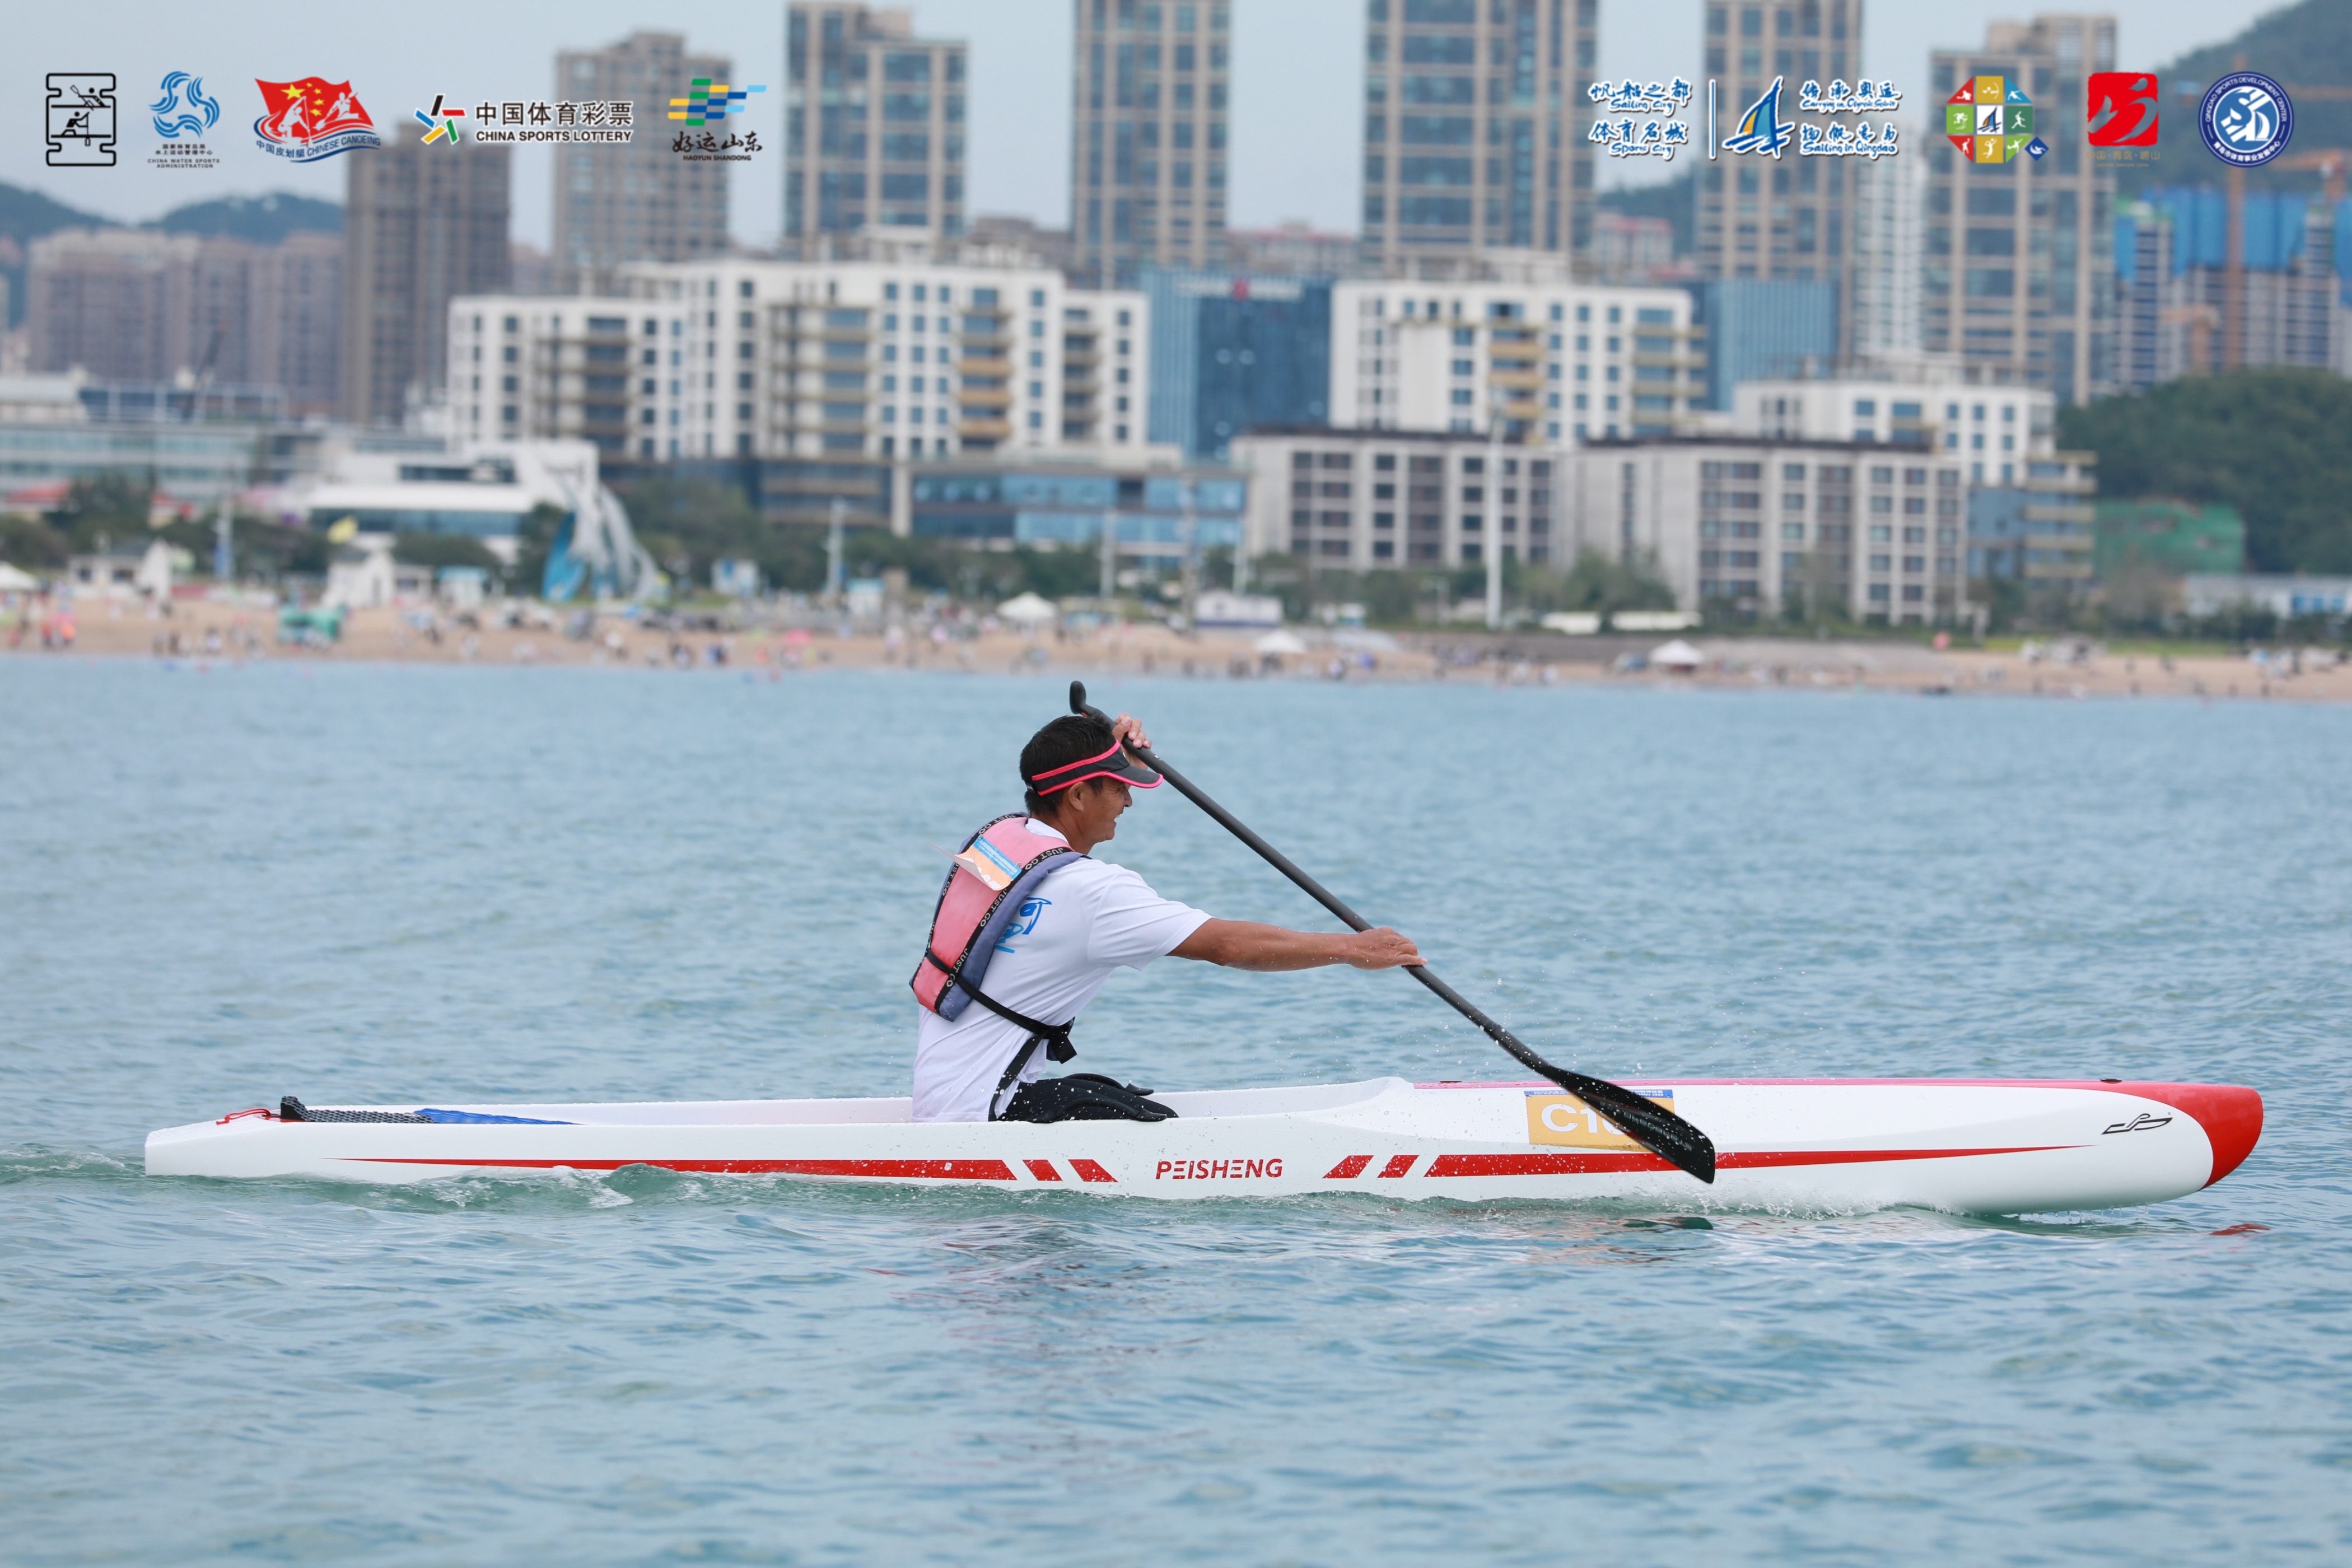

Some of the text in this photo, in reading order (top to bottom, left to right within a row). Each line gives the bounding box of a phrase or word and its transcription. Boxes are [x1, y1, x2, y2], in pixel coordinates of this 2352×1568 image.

[978, 823, 992, 834] GO
[1025, 847, 1063, 870] JUST GO
[980, 888, 1007, 927] JUST GO
[946, 948, 969, 987] JUST GO
[1155, 1158, 1283, 1180] PEISHENG
